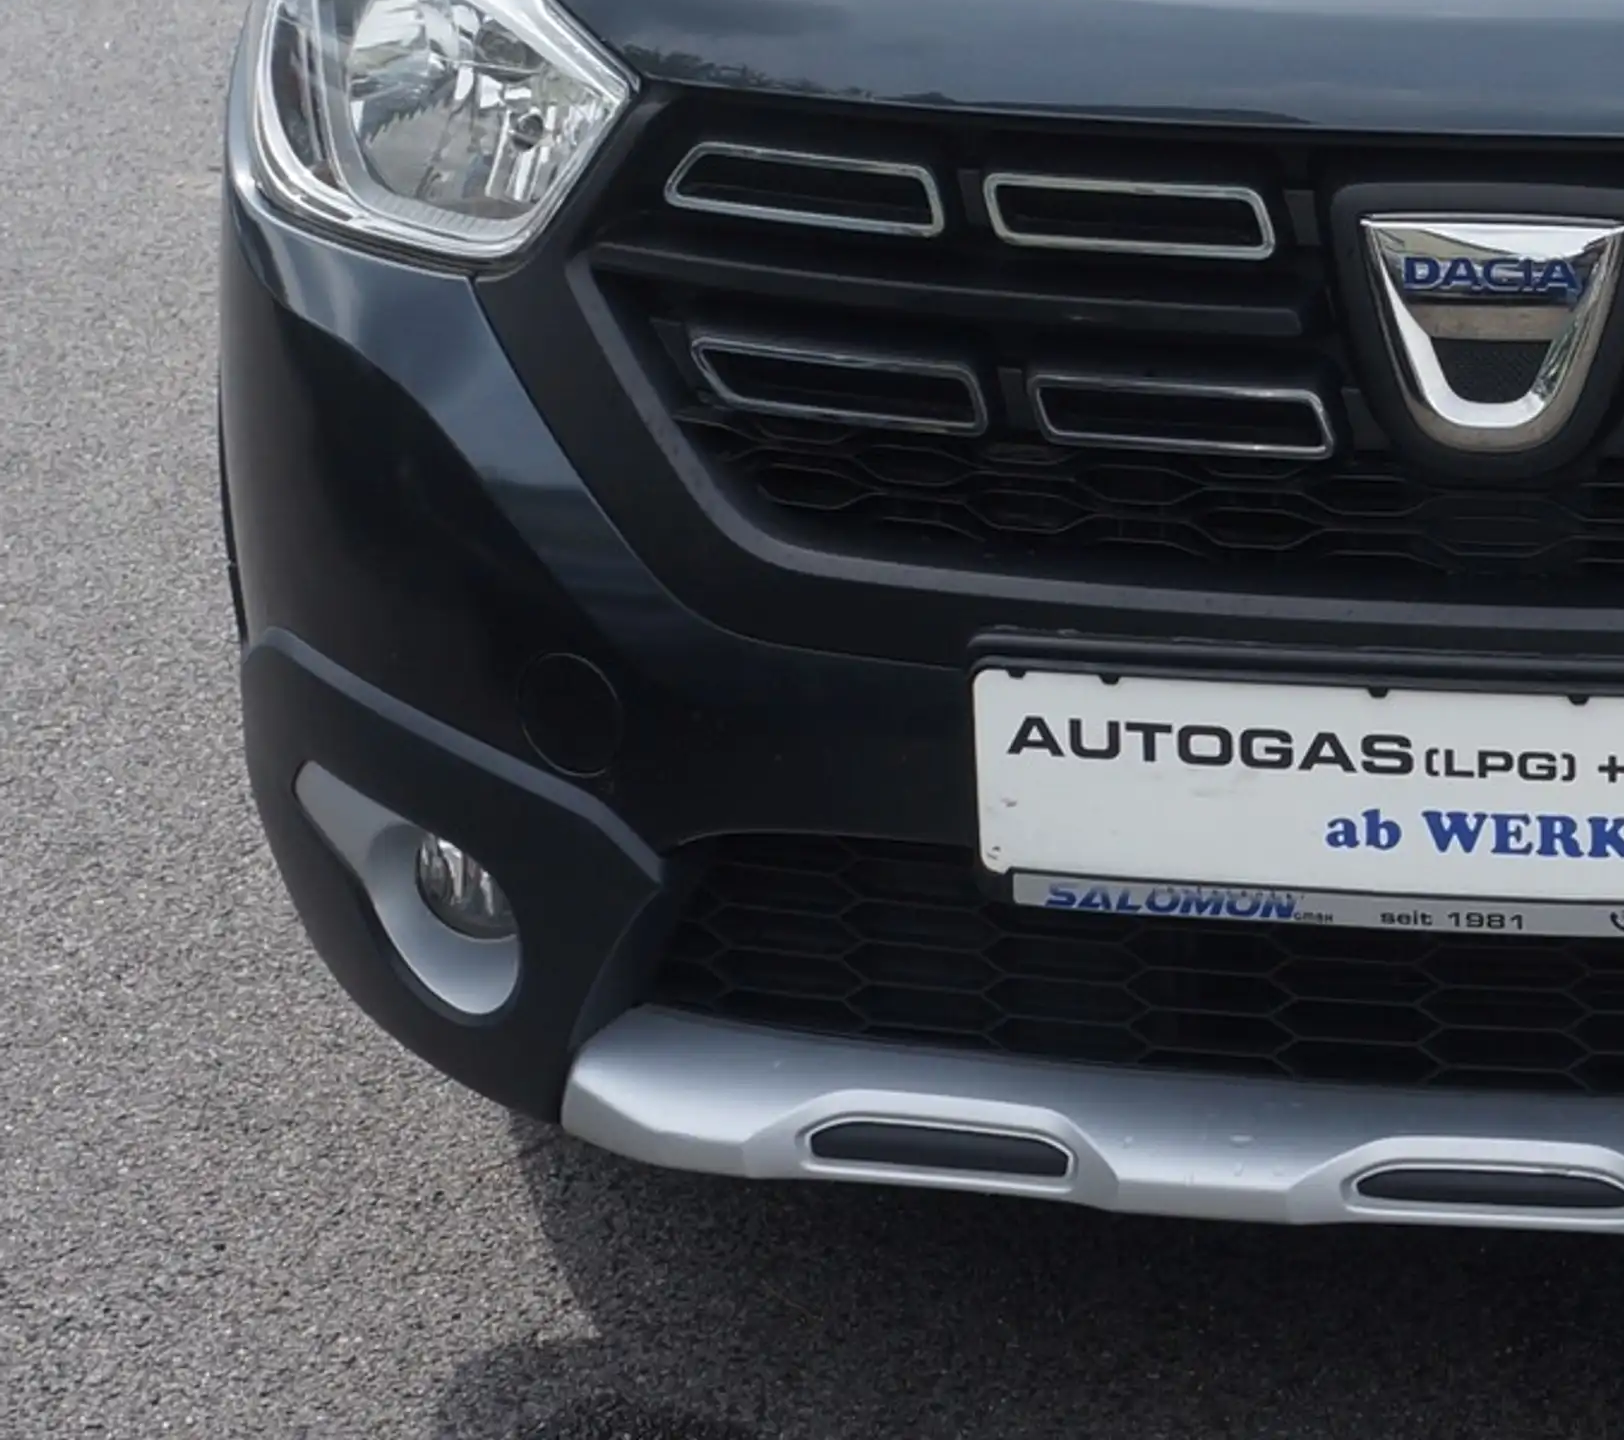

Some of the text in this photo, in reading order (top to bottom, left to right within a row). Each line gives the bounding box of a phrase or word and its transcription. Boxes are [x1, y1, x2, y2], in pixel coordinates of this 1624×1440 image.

[1403, 257, 1580, 294] DACIA
[1006, 715, 1414, 776] AUTOGAS
[1424, 747, 1576, 782] (LPG)
[1325, 808, 1402, 851] ab
[1045, 882, 1297, 920] SALOMON
[1380, 910, 1433, 926] seit
[1447, 911, 1524, 930] 1981
